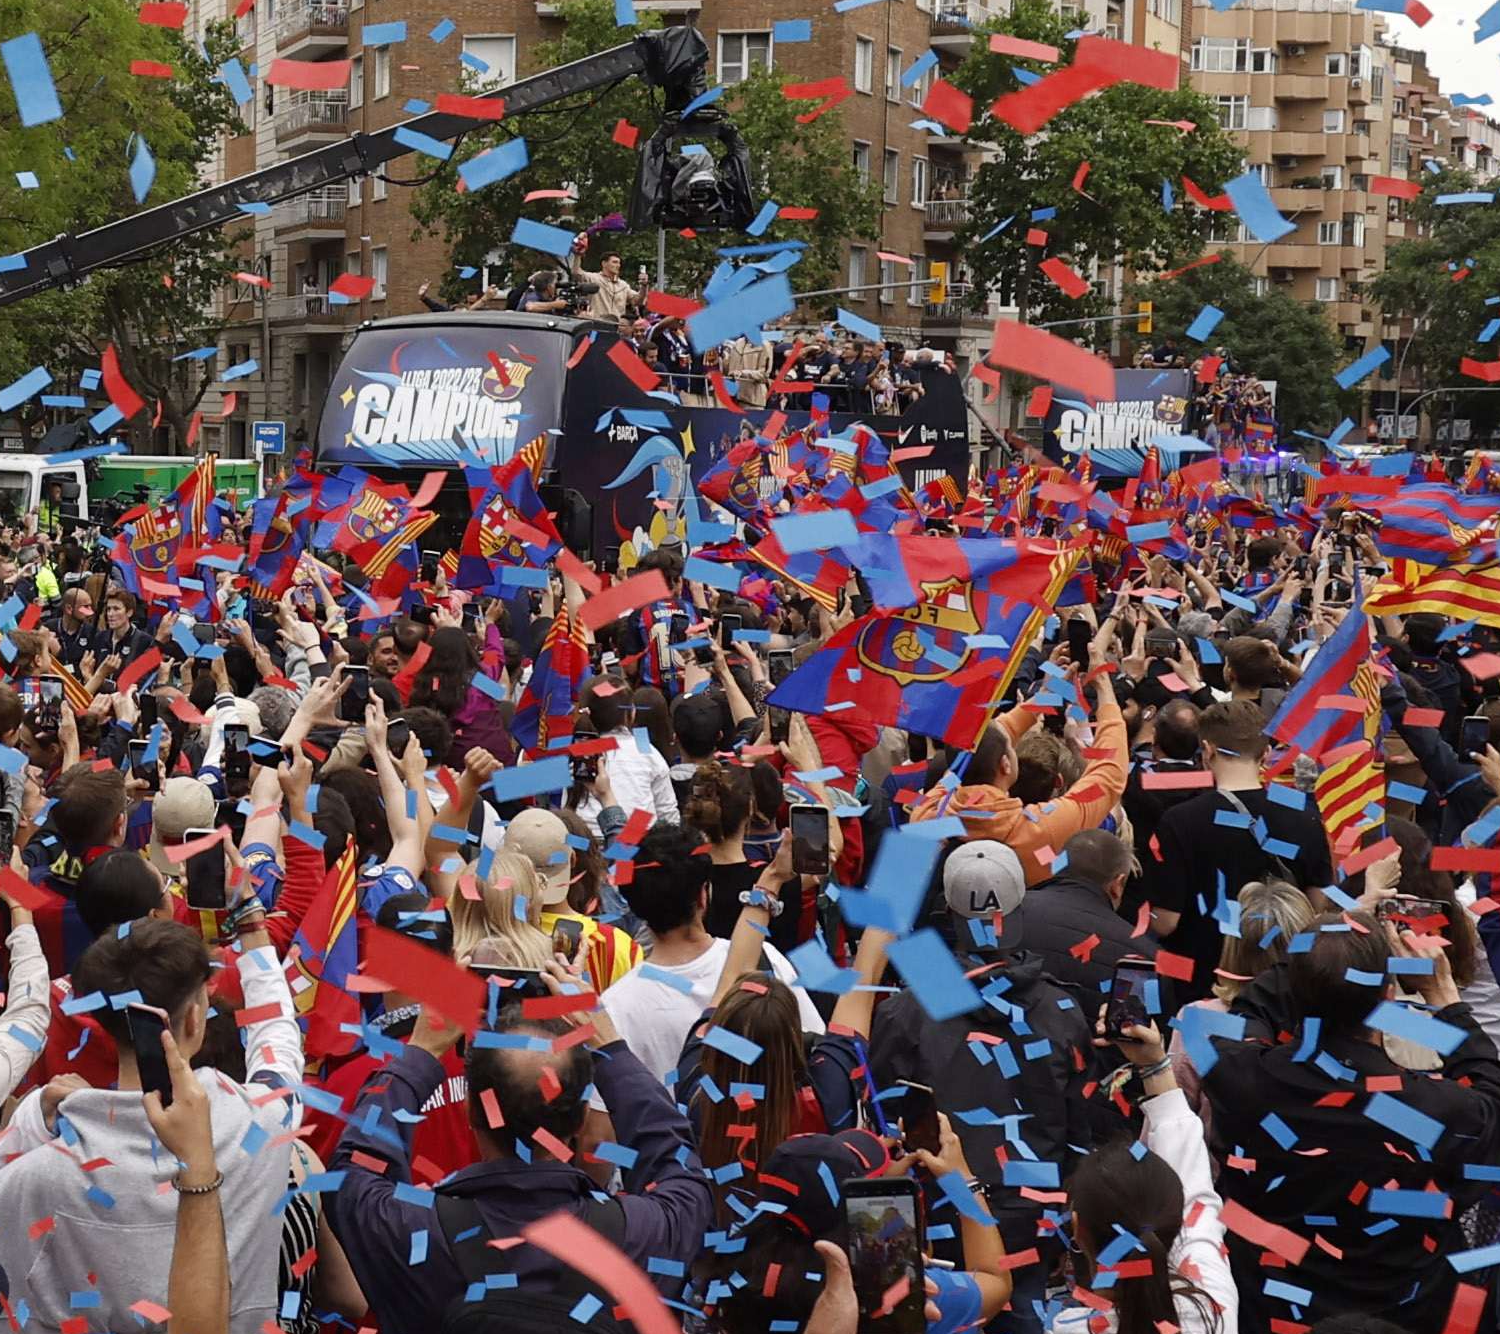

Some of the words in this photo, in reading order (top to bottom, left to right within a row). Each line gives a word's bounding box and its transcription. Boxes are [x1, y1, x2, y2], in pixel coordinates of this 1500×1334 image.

[402, 370, 433, 389] LLIGA
[433, 367, 483, 395] 2022/23
[352, 383, 522, 448] CAMPIONS
[970, 889, 1001, 912] LA
